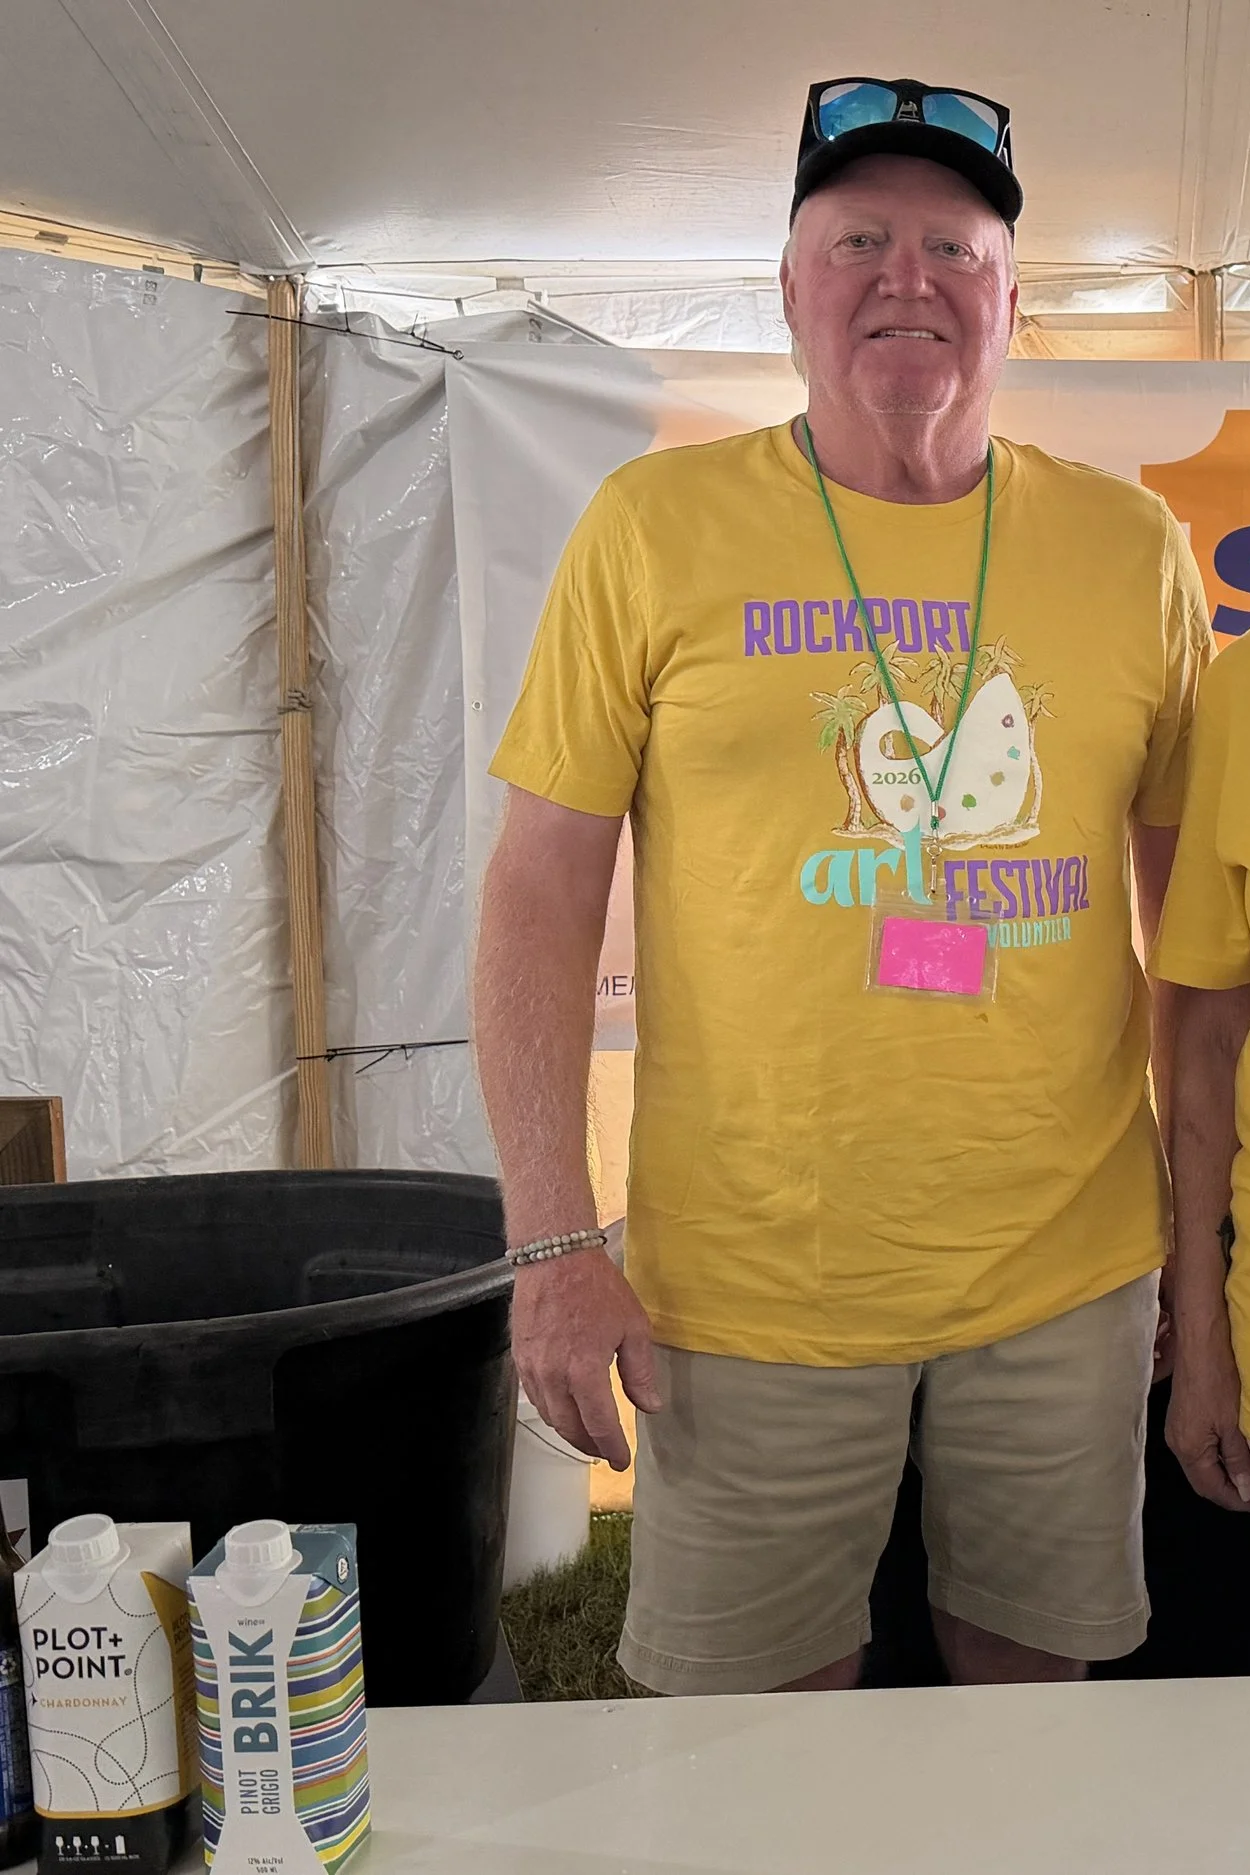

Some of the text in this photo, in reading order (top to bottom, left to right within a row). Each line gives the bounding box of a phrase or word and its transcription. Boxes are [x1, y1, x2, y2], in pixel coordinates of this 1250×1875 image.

[744, 597, 971, 656] ROCKPORT
[872, 767, 922, 785] 2026
[801, 814, 1090, 921] art FESTIVAL
[988, 917, 1072, 948] VOLUNTEER
[40, 1696, 127, 1709] CHARDONNAY
[228, 1628, 279, 1752] BRIK
[238, 1769, 260, 1815] PINOT
[259, 1768, 281, 1815] GRIGIO
